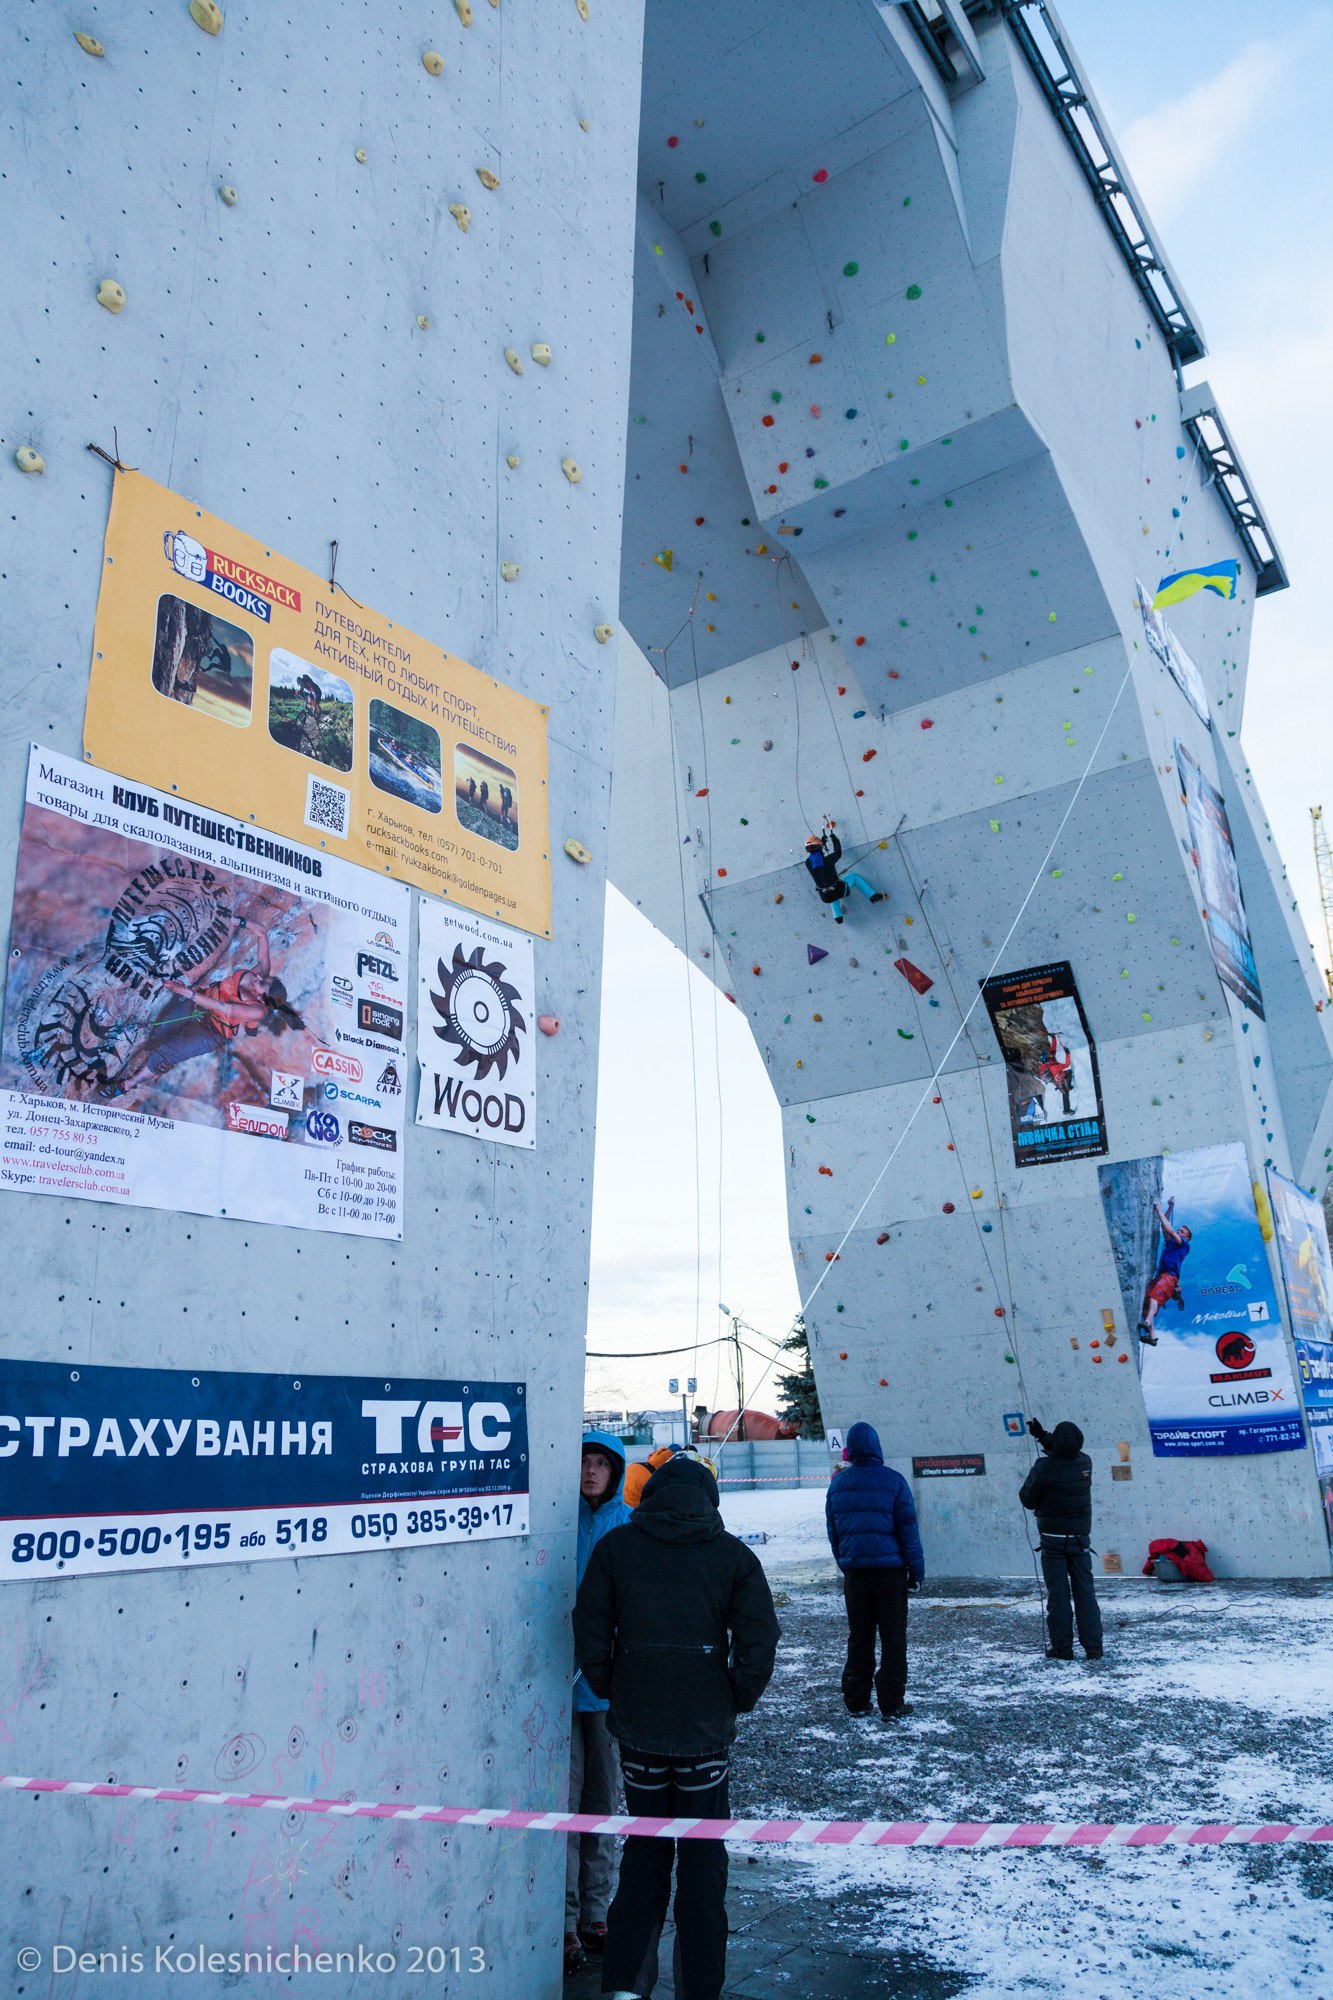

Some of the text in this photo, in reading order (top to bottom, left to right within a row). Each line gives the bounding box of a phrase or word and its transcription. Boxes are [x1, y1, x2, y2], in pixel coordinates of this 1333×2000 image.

[213, 555, 296, 608] RUCKSACK
[211, 575, 267, 619] BOOKS
[315, 601, 411, 664] ПУТЕВОДИТЕЛИ
[314, 620, 481, 722] ДЛЯ ТЕХ, КТО ЛЮБИТ СПОРТ,
[314, 640, 517, 757] АКТИВНЫЙ ОТДЫХ И ПУТЕШЕСТВИЯ
[39, 763, 322, 878] Магазин КЛУБ ПУТЕШЕСТВЕННИКОВ
[366, 823, 448, 865] rucksackbooks.com
[367, 807, 503, 875] г. Харьков, тел. (057) 701-0-701
[37, 791, 397, 928] товары для скалолазания, альпинизма и активного отдыха
[366, 838, 517, 909] e-mail: ryukzakbook@goldenpages.ua
[444, 916, 513, 949] getwood.com.ua
[357, 951, 399, 983] PETZL
[17, 959, 71, 1094] www.travelersclub.com.ua
[371, 1016, 391, 1029] rock
[372, 1010, 400, 1027] singing
[343, 1033, 400, 1055] Black Diamond
[315, 1052, 361, 1078] CASSIN
[340, 1090, 381, 1109] SCARPA
[376, 1084, 401, 1096] CAMP
[433, 1072, 526, 1133] WOOD
[7, 1109, 140, 1138] ул. Донец-Захаржевского, 2
[19, 1094, 67, 1112] Харьков,
[82, 1103, 145, 1125] Исторический
[147, 1115, 175, 1131] Музей
[5, 1124, 98, 1146] тел. 057 755 80 53
[4, 1139, 125, 1166] email: ed-tour@yandex.ru
[2, 1154, 125, 1181] www.travelersclub.com.ua
[336, 1158, 397, 1180] График работы:
[1, 1169, 130, 1196] Skype: travelersclub.com.ua
[304, 1168, 332, 1183] Пн-Пт
[342, 1175, 363, 1188] 10-00
[365, 1182, 375, 1191] до
[376, 1181, 397, 1195] 20-00
[317, 1187, 397, 1210] Сб с 10-00 до 19-00
[318, 1203, 330, 1215] Вс
[338, 1206, 360, 1219] 11-00
[361, 1212, 372, 1221] до
[374, 1211, 396, 1224] 17-00
[1200, 1283, 1242, 1297] BOREAL
[1212, 1369, 1270, 1383] MAMMUT
[0, 1415, 333, 1458] СТРАХУВАННЯ
[361, 1399, 512, 1455] ТАС
[1154, 1430, 1227, 1440] ДРАЙВ-СПОРТ
[1265, 1432, 1301, 1443] 771-82-24
[1164, 1440, 1224, 1448] www.drive-sport.com.ua
[361, 1457, 511, 1476] СТРАХОВА ГРУПА ТАС
[915, 1457, 982, 1469] krukonogi.com
[239, 1530, 266, 1547] або
[276, 1517, 328, 1545] 518
[351, 1513, 398, 1538] 050
